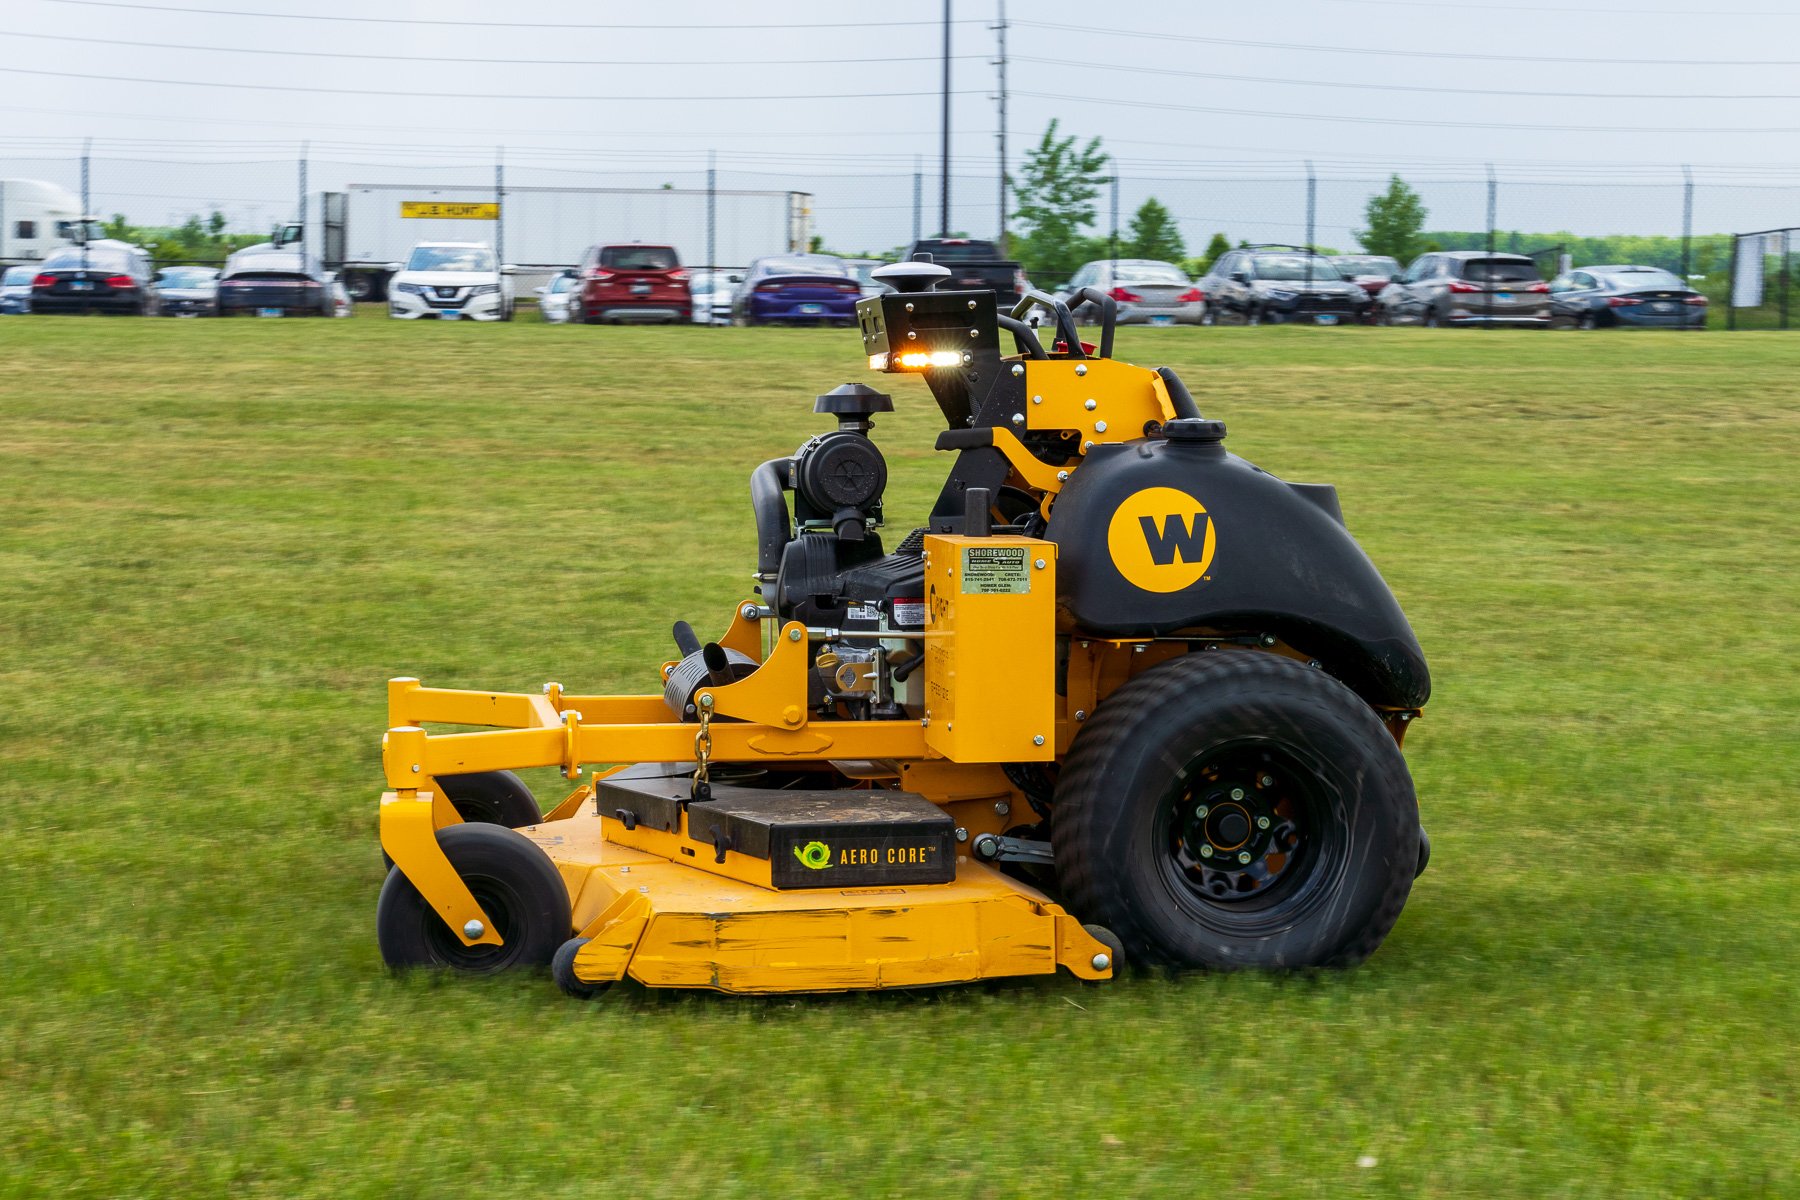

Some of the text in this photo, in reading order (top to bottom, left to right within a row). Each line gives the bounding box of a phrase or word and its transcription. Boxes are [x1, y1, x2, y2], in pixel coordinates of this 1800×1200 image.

[1138, 513, 1209, 565] W
[969, 548, 1024, 557] SHOREWOOD
[840, 849, 878, 865] AERO
[887, 847, 926, 864] CORE
